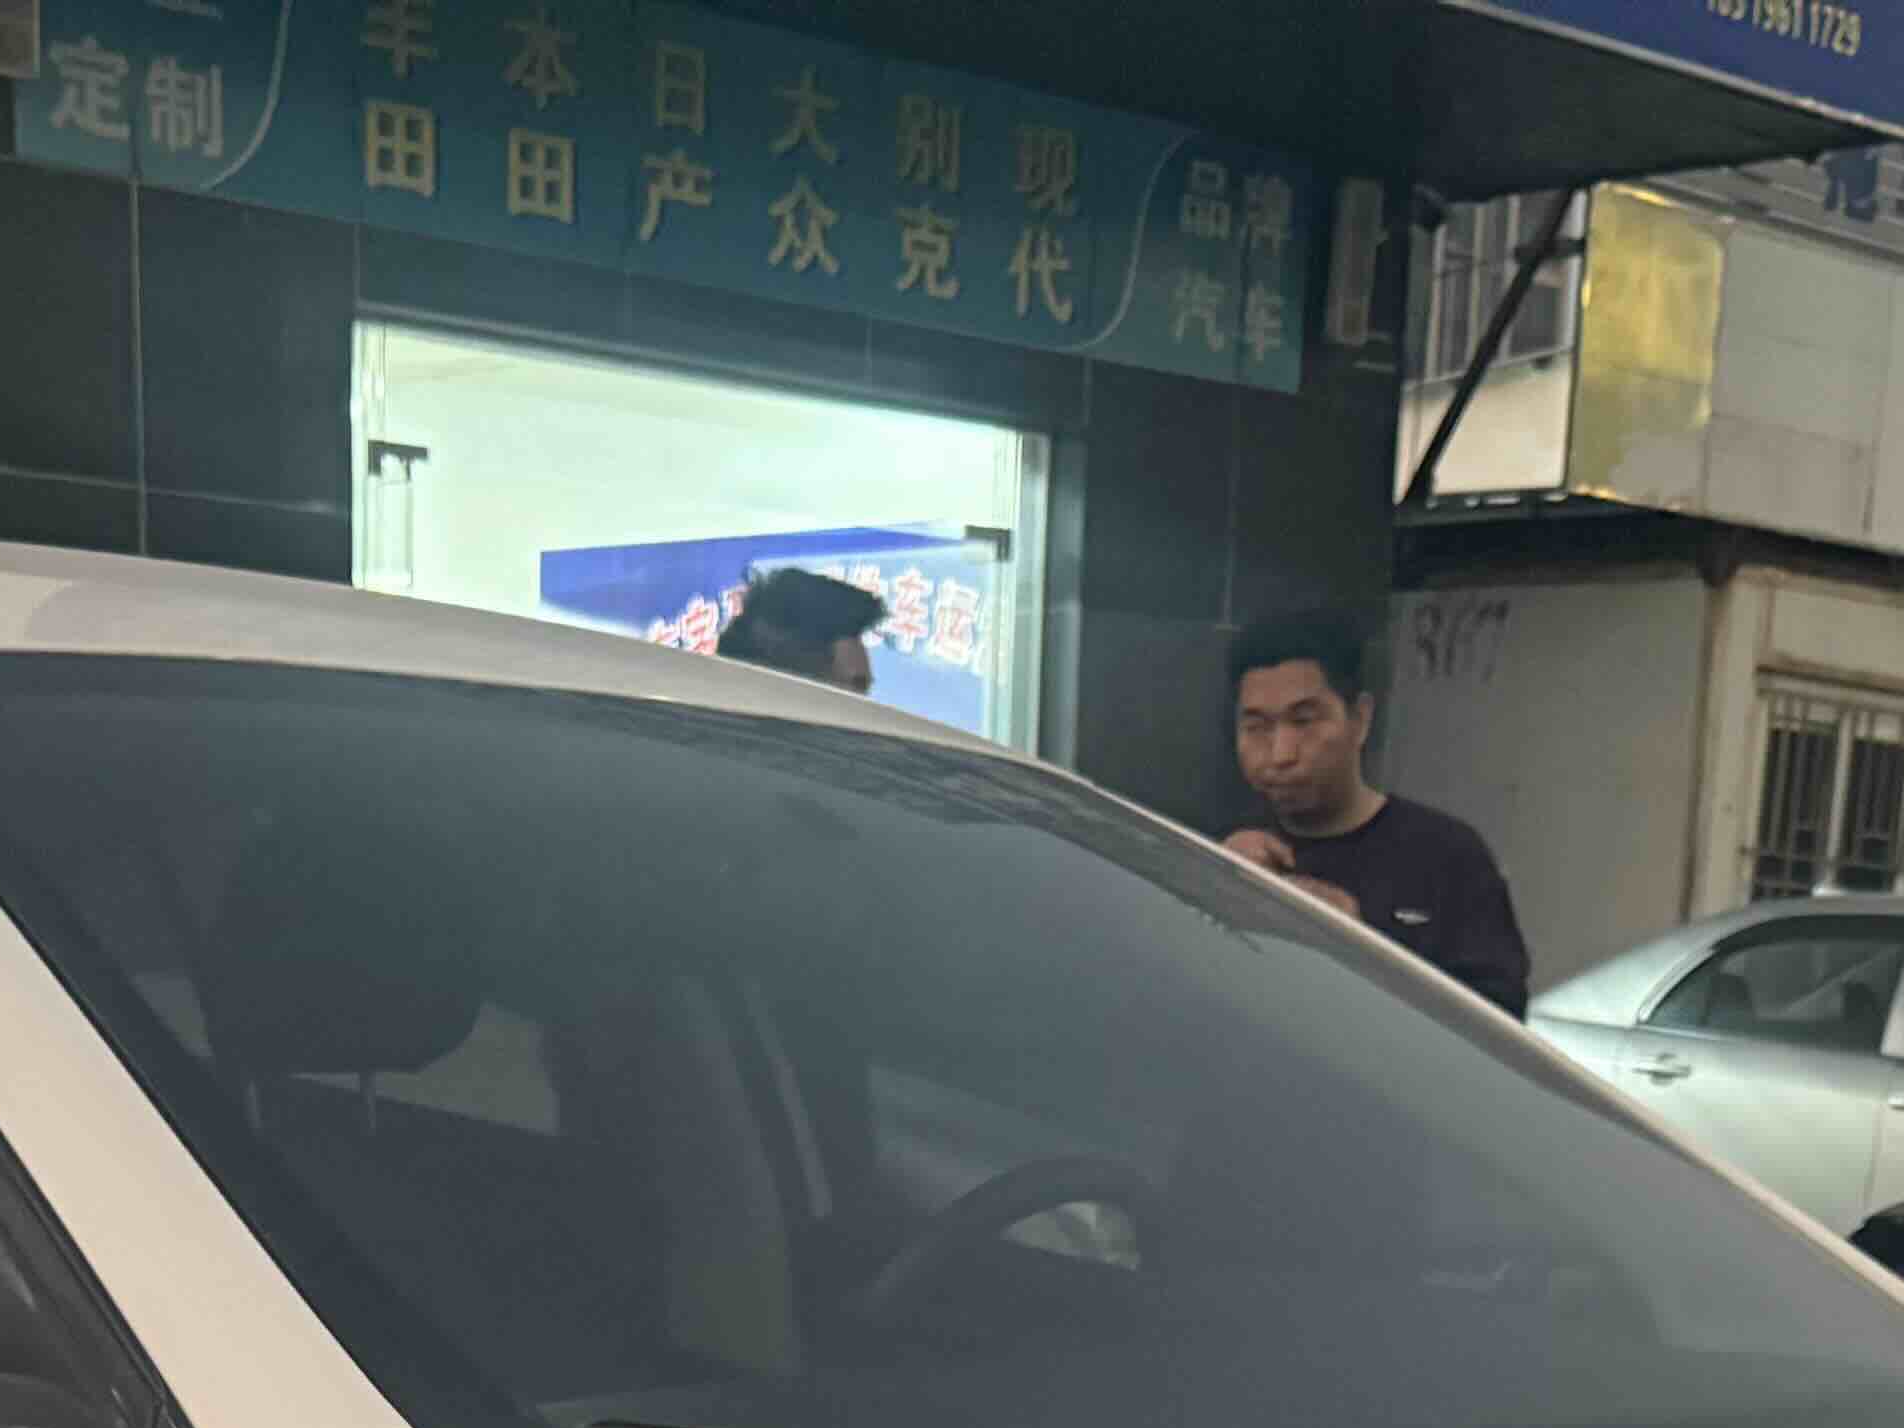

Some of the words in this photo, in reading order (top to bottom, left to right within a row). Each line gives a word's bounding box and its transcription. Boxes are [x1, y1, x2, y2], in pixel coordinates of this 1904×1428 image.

[49, 35, 224, 158] 定制
[504, 4, 578, 224] 本田
[639, 41, 713, 241] 日产
[767, 65, 841, 274] 大众
[896, 93, 962, 299] 别克
[1009, 123, 1077, 324] 现代
[1180, 160, 1294, 250] 品牌
[1172, 270, 1290, 362] 汽车
